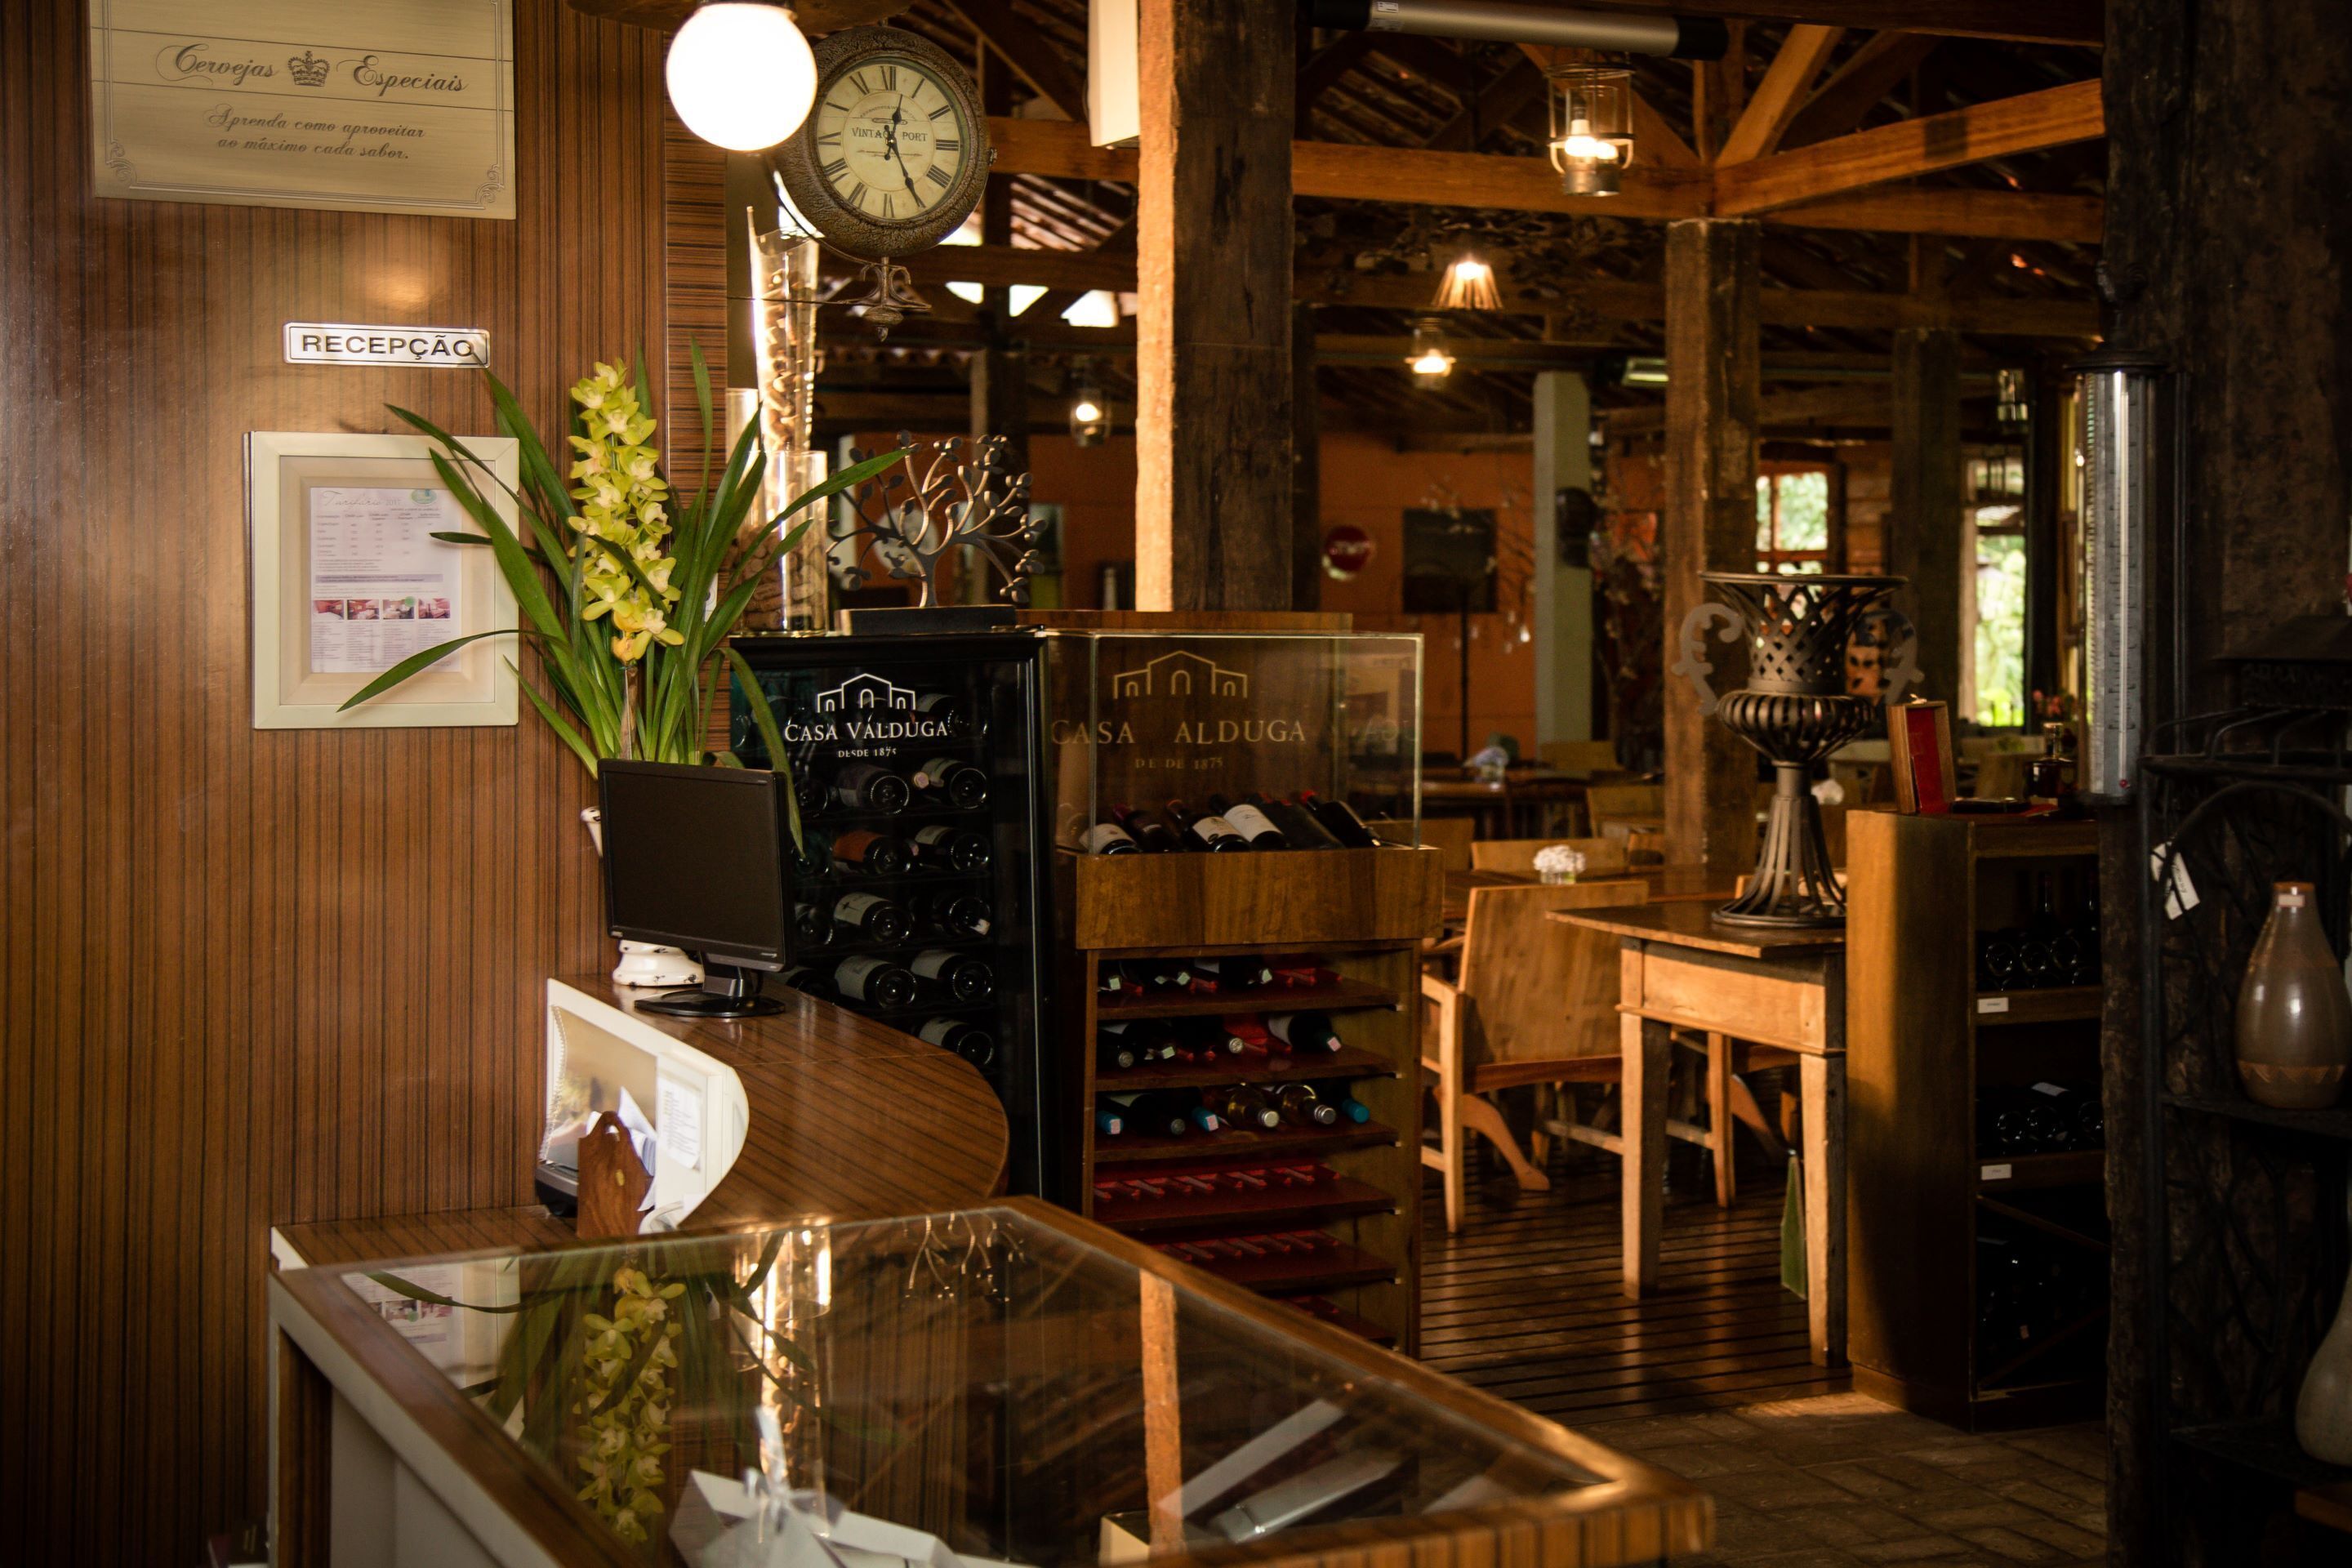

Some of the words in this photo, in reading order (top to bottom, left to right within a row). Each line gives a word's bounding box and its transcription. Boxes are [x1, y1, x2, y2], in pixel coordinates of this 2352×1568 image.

[156, 43, 278, 86] Cervejas
[336, 55, 470, 96] Especiais
[203, 104, 290, 131] Aprenda
[295, 120, 336, 131] como
[342, 122, 425, 138] aproveitar
[852, 127, 895, 139] VINTA
[902, 131, 929, 142] PORT
[216, 137, 239, 149] ao
[245, 136, 308, 153] máximo
[314, 141, 356, 157] cada
[359, 142, 409, 159] sabor.
[301, 334, 474, 360] RECEPÇÃO
[784, 724, 839, 742] CASA
[845, 721, 949, 739] VALDUGA
[1051, 719, 1136, 745] CASA
[838, 748, 869, 759] DESDE
[875, 746, 898, 757] 1875
